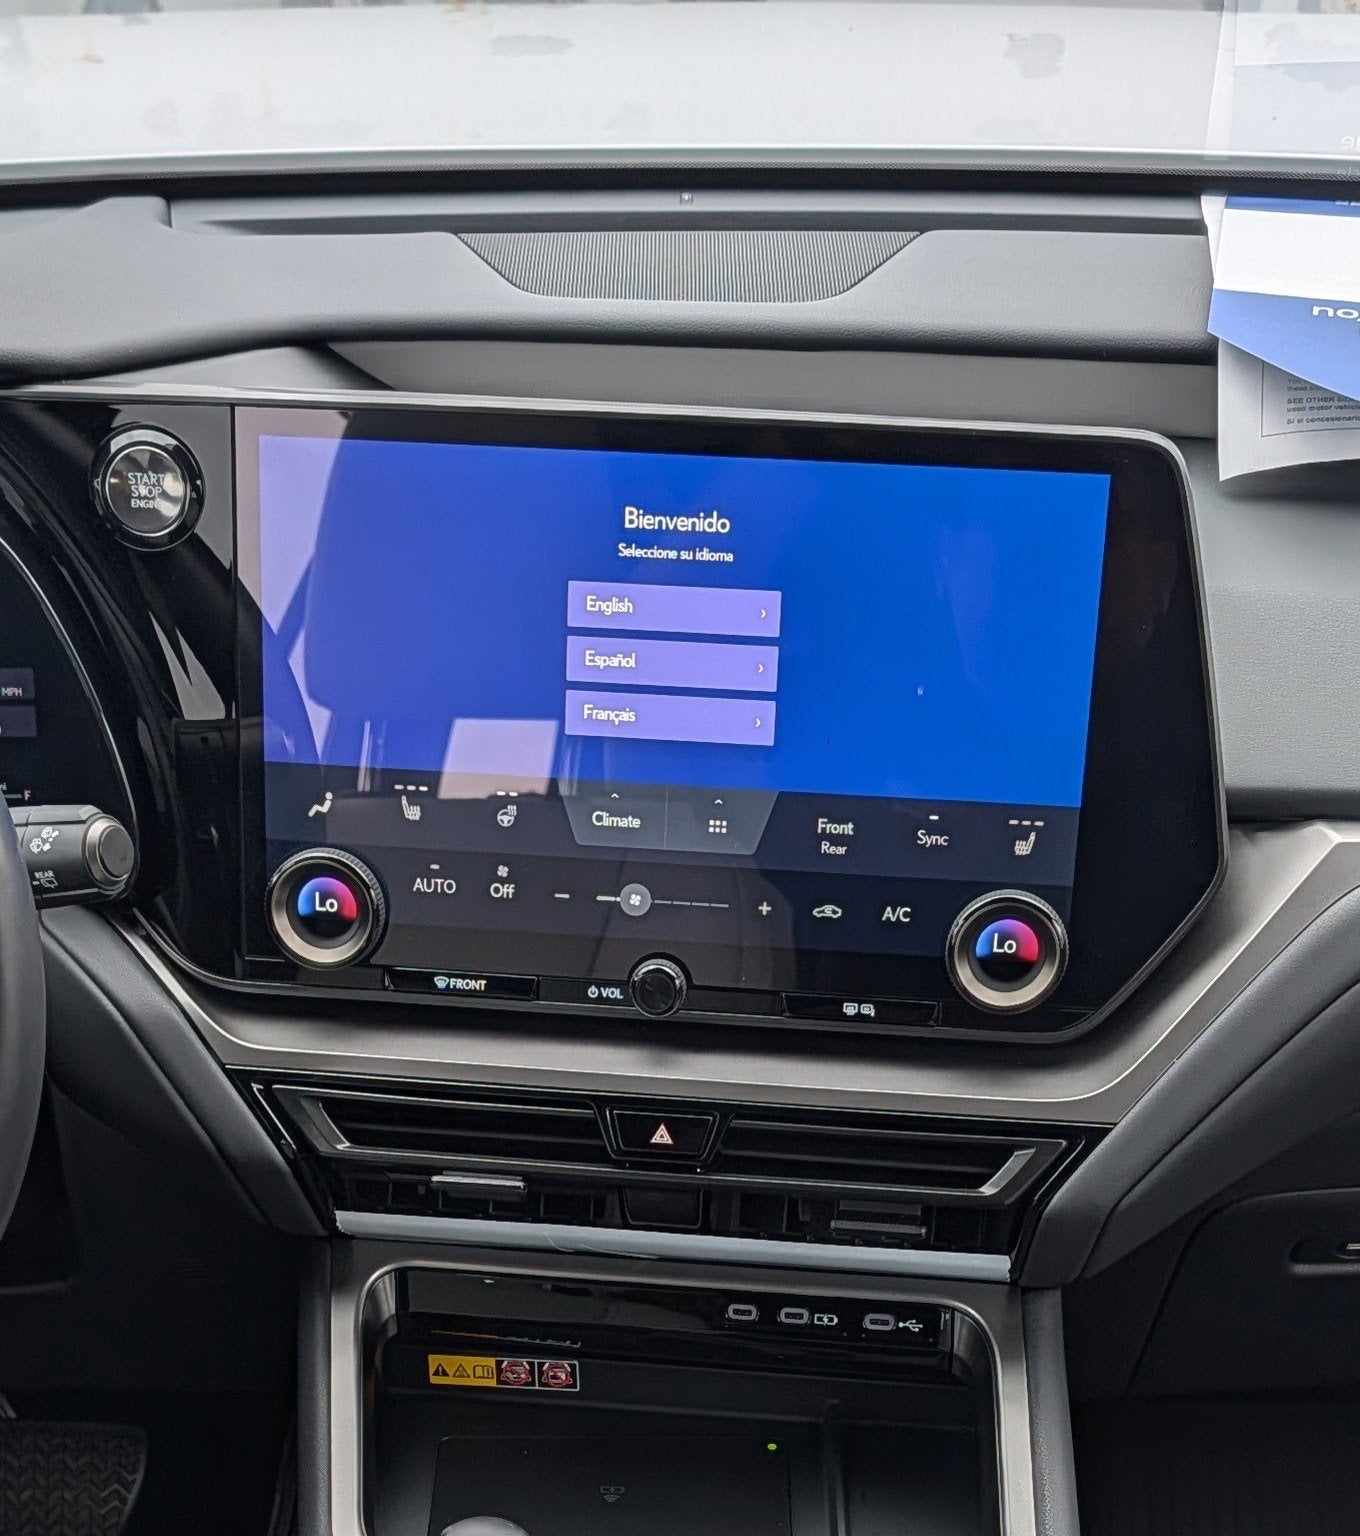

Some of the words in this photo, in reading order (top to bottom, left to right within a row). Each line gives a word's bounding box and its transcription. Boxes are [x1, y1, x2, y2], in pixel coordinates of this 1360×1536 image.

[127, 471, 165, 486] START
[623, 506, 731, 534] Bienvenido
[617, 543, 678, 560] Seleccione
[680, 549, 693, 561] su
[695, 547, 734, 563] idioma
[585, 594, 634, 616] English
[584, 649, 637, 670] Español
[1, 686, 23, 697] MPH
[583, 704, 637, 726] Français
[591, 811, 641, 829] Climate
[817, 818, 855, 836] Front
[916, 830, 950, 848] Sync
[820, 841, 848, 856] Rear
[33, 870, 56, 879] REAR
[412, 877, 457, 895] AUTO
[489, 882, 516, 900] Off
[313, 891, 339, 913] Lo
[881, 905, 912, 924] A/C
[992, 932, 1018, 955] Lo
[449, 977, 488, 992] FRONT
[600, 986, 624, 999] VOL
